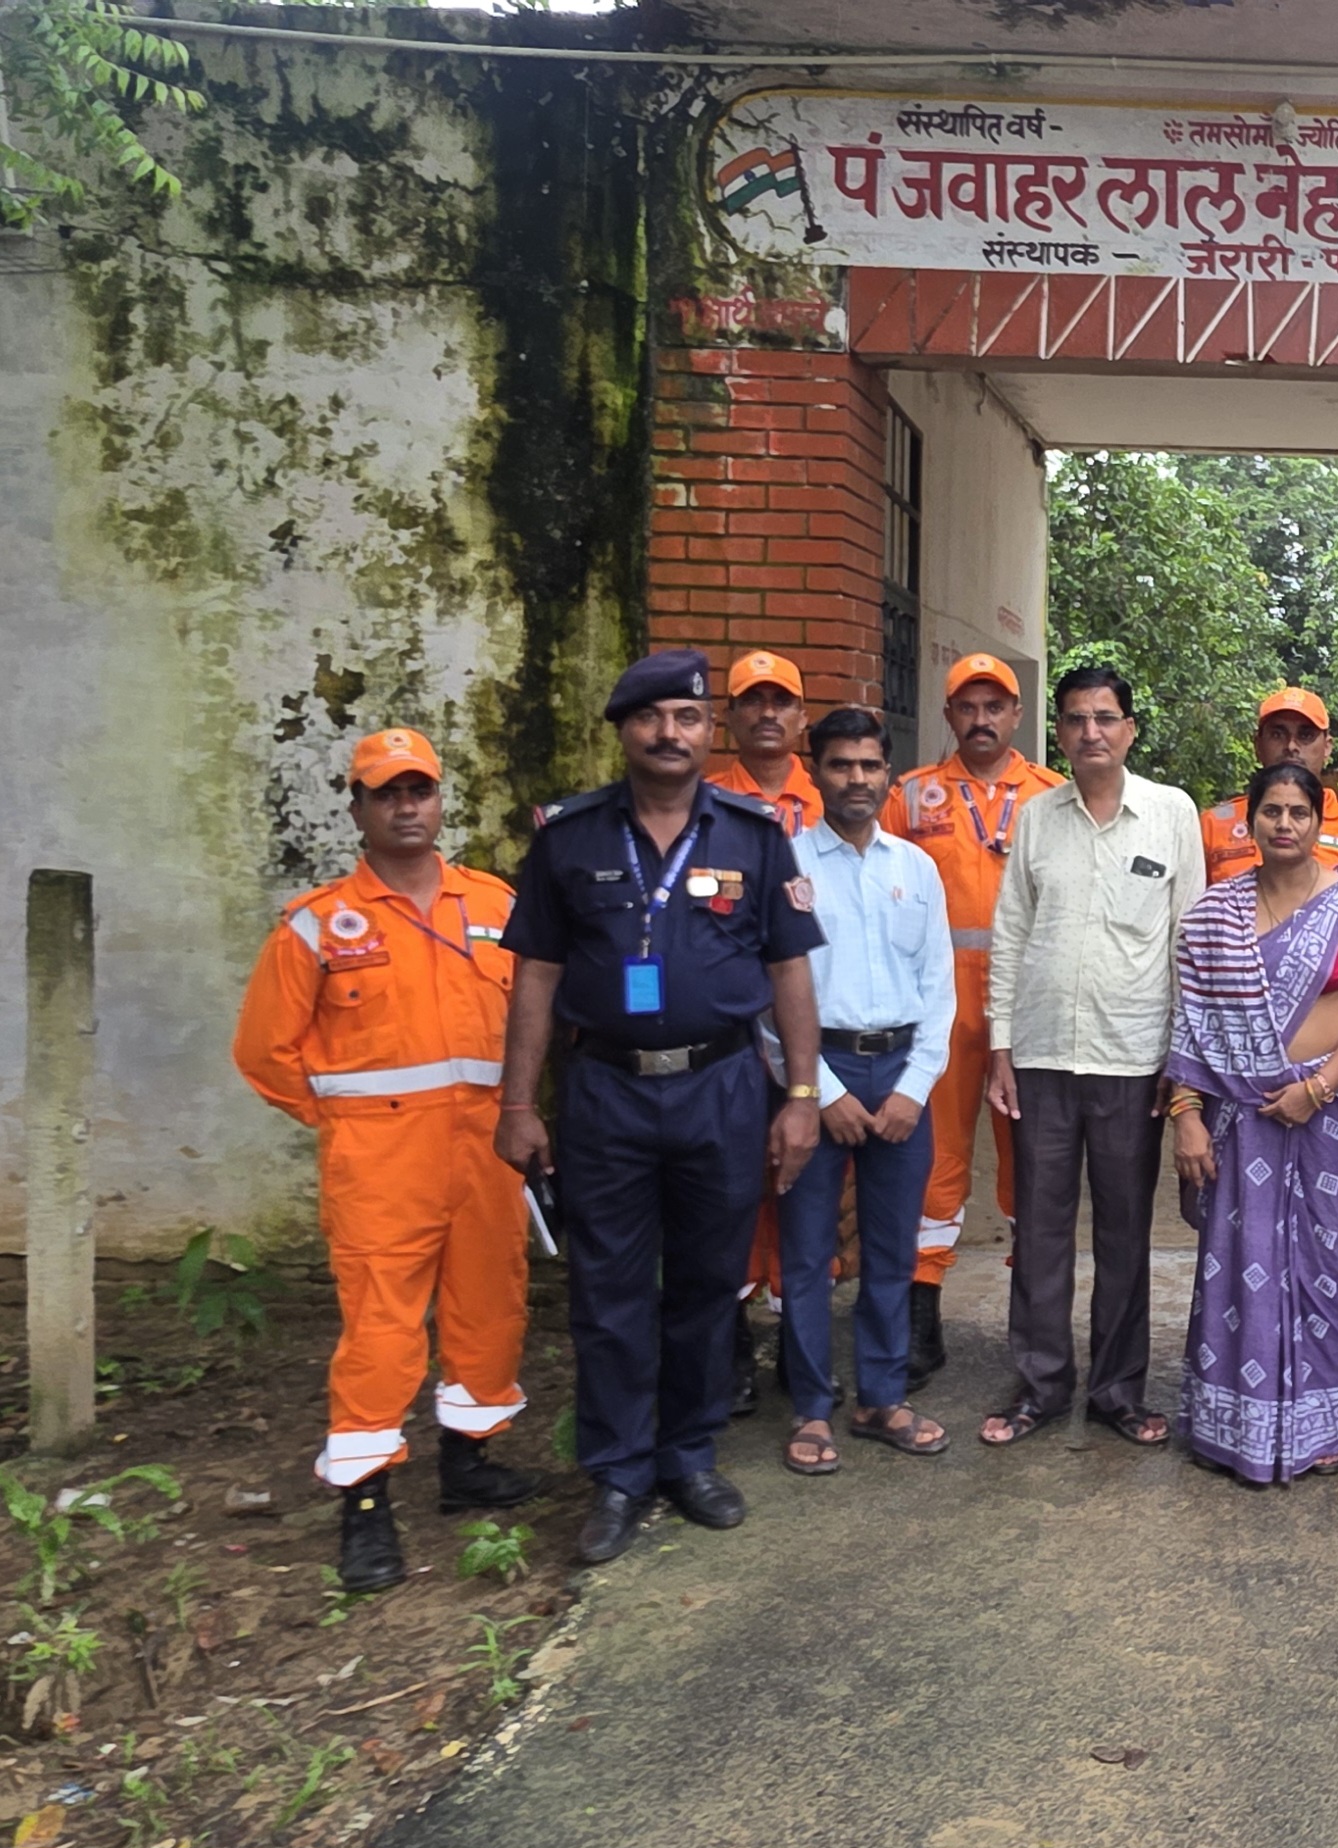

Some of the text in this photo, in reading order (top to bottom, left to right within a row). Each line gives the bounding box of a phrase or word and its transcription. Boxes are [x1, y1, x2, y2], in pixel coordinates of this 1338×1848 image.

[897, 103, 1004, 145] संस्थापित
[826, 131, 886, 218] पं
[982, 231, 1100, 268] संस्थापक
